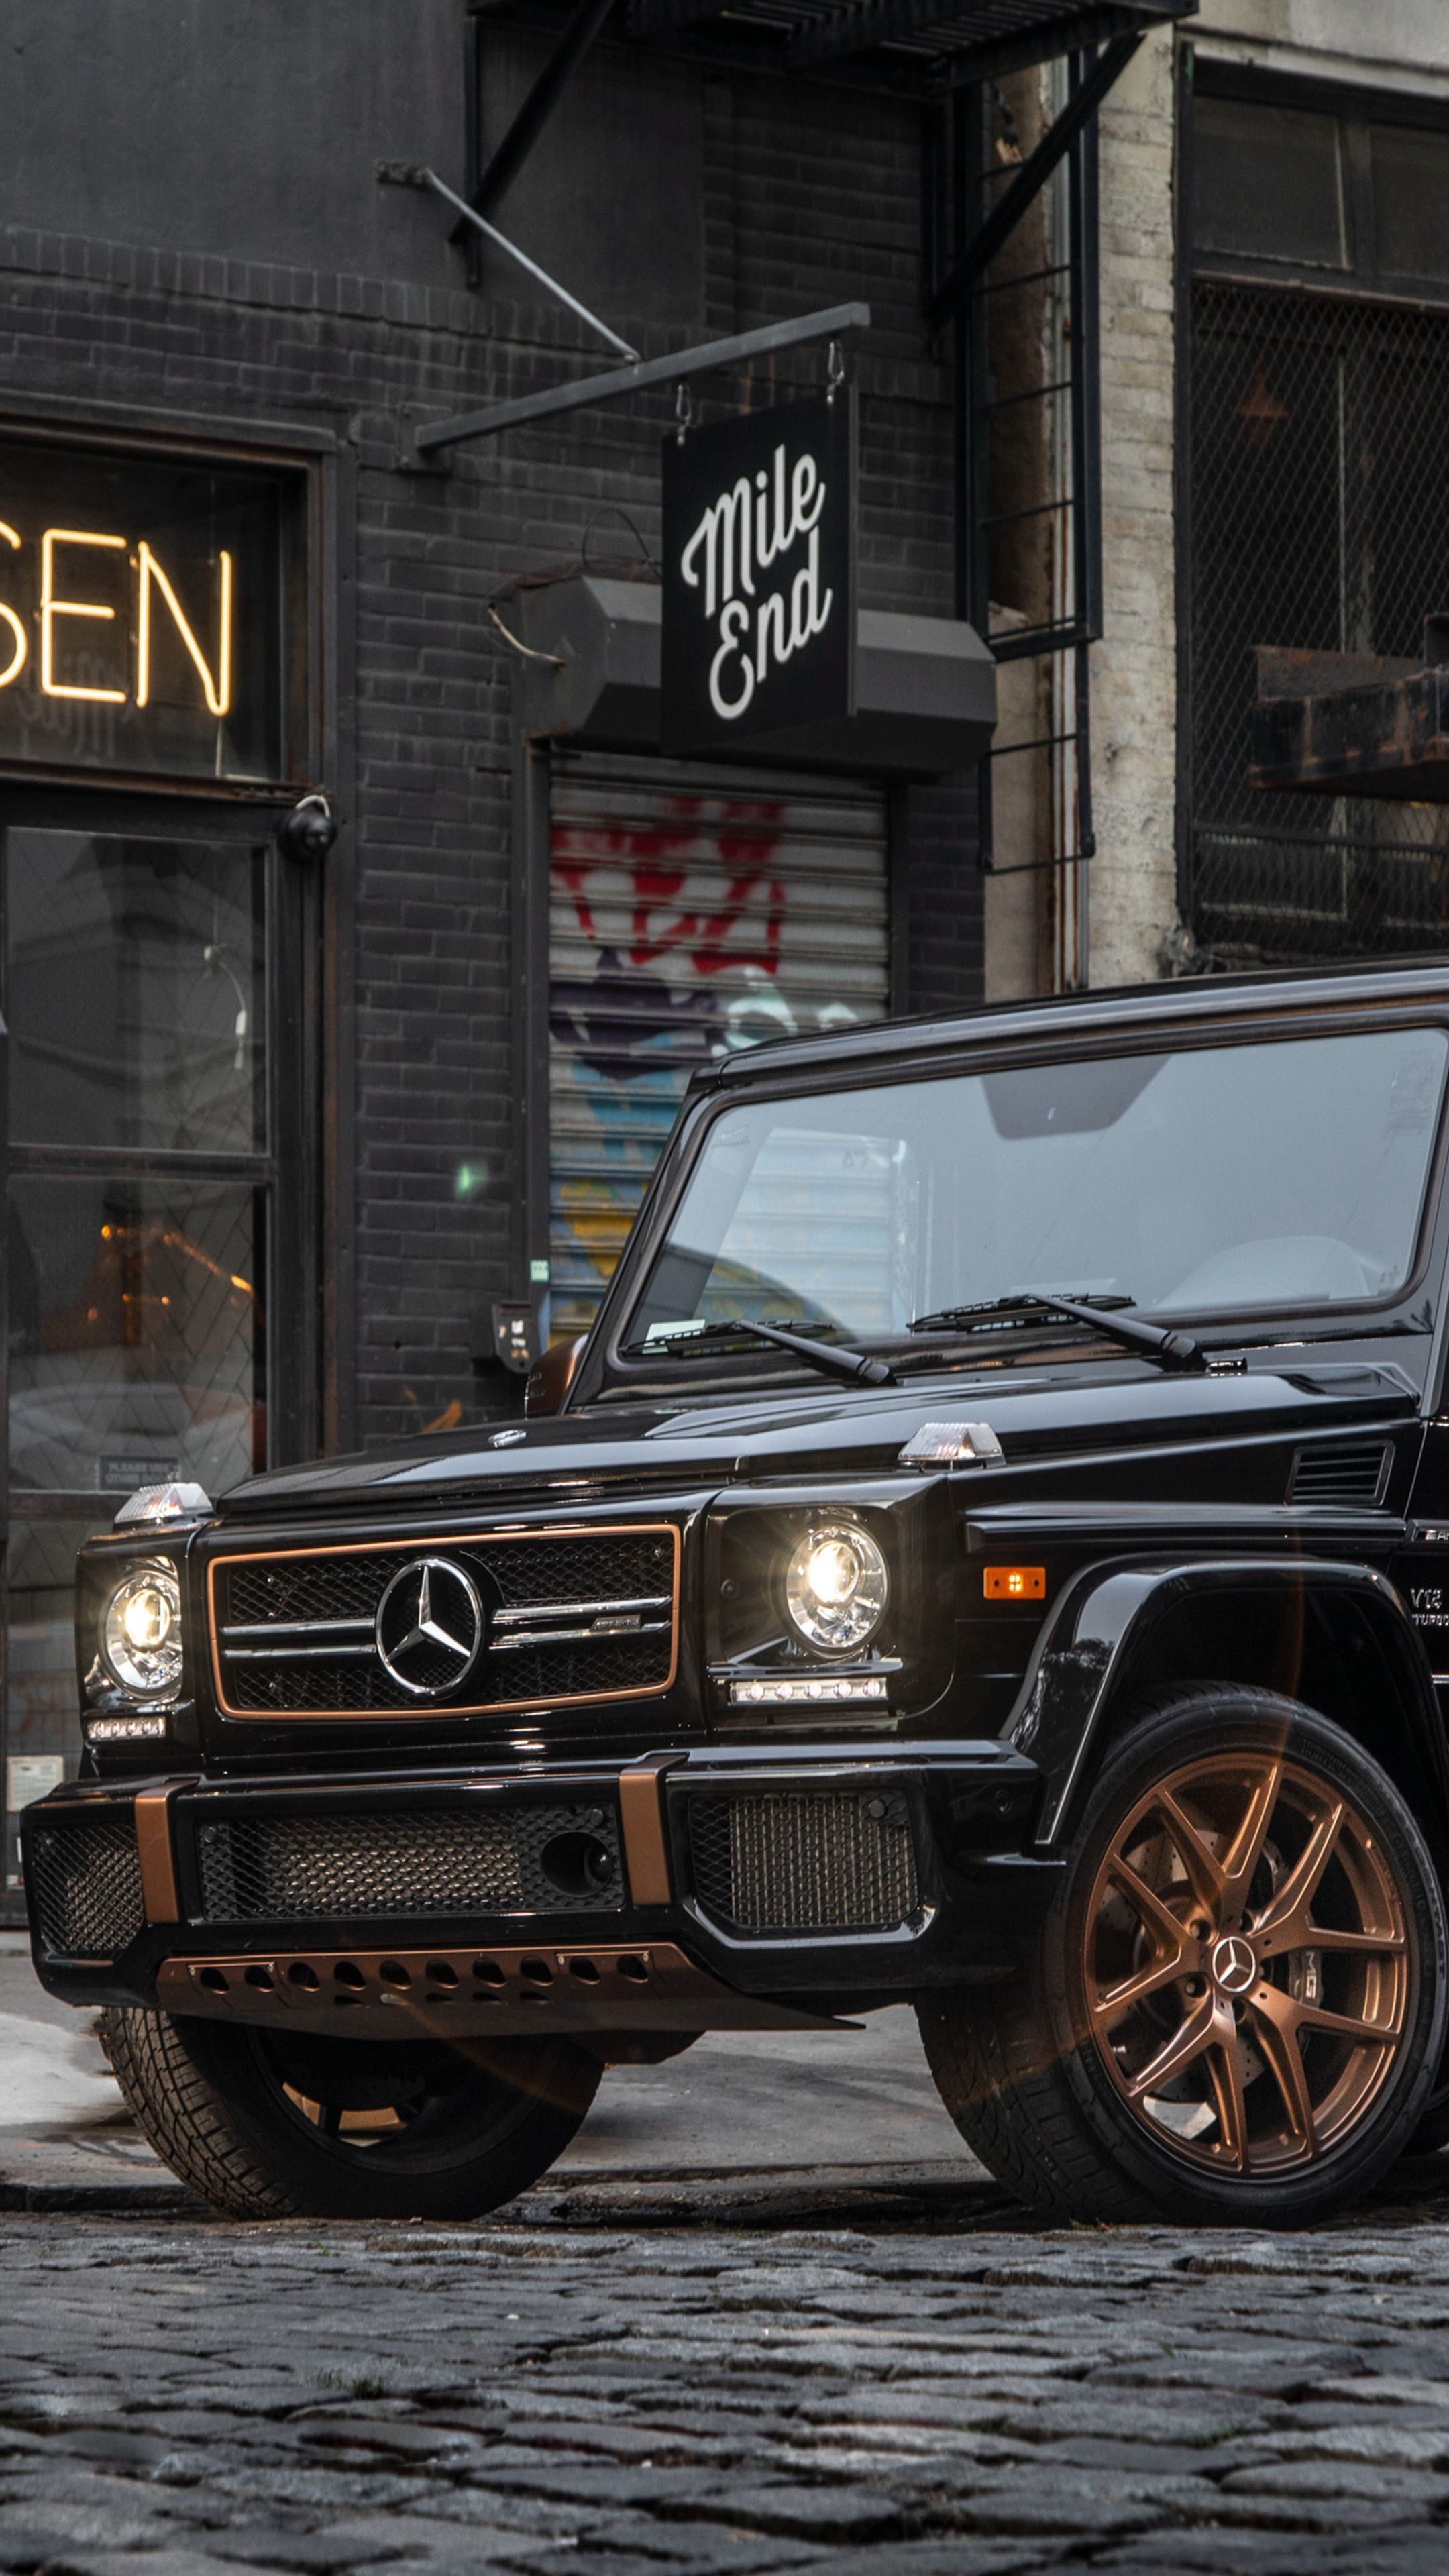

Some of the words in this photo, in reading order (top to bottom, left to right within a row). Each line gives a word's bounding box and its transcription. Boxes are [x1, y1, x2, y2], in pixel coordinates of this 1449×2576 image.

[680, 443, 826, 618] Mile
[709, 525, 833, 720] End
[1410, 1587, 1443, 1609] V12
[1305, 1951, 1317, 1999] MG
